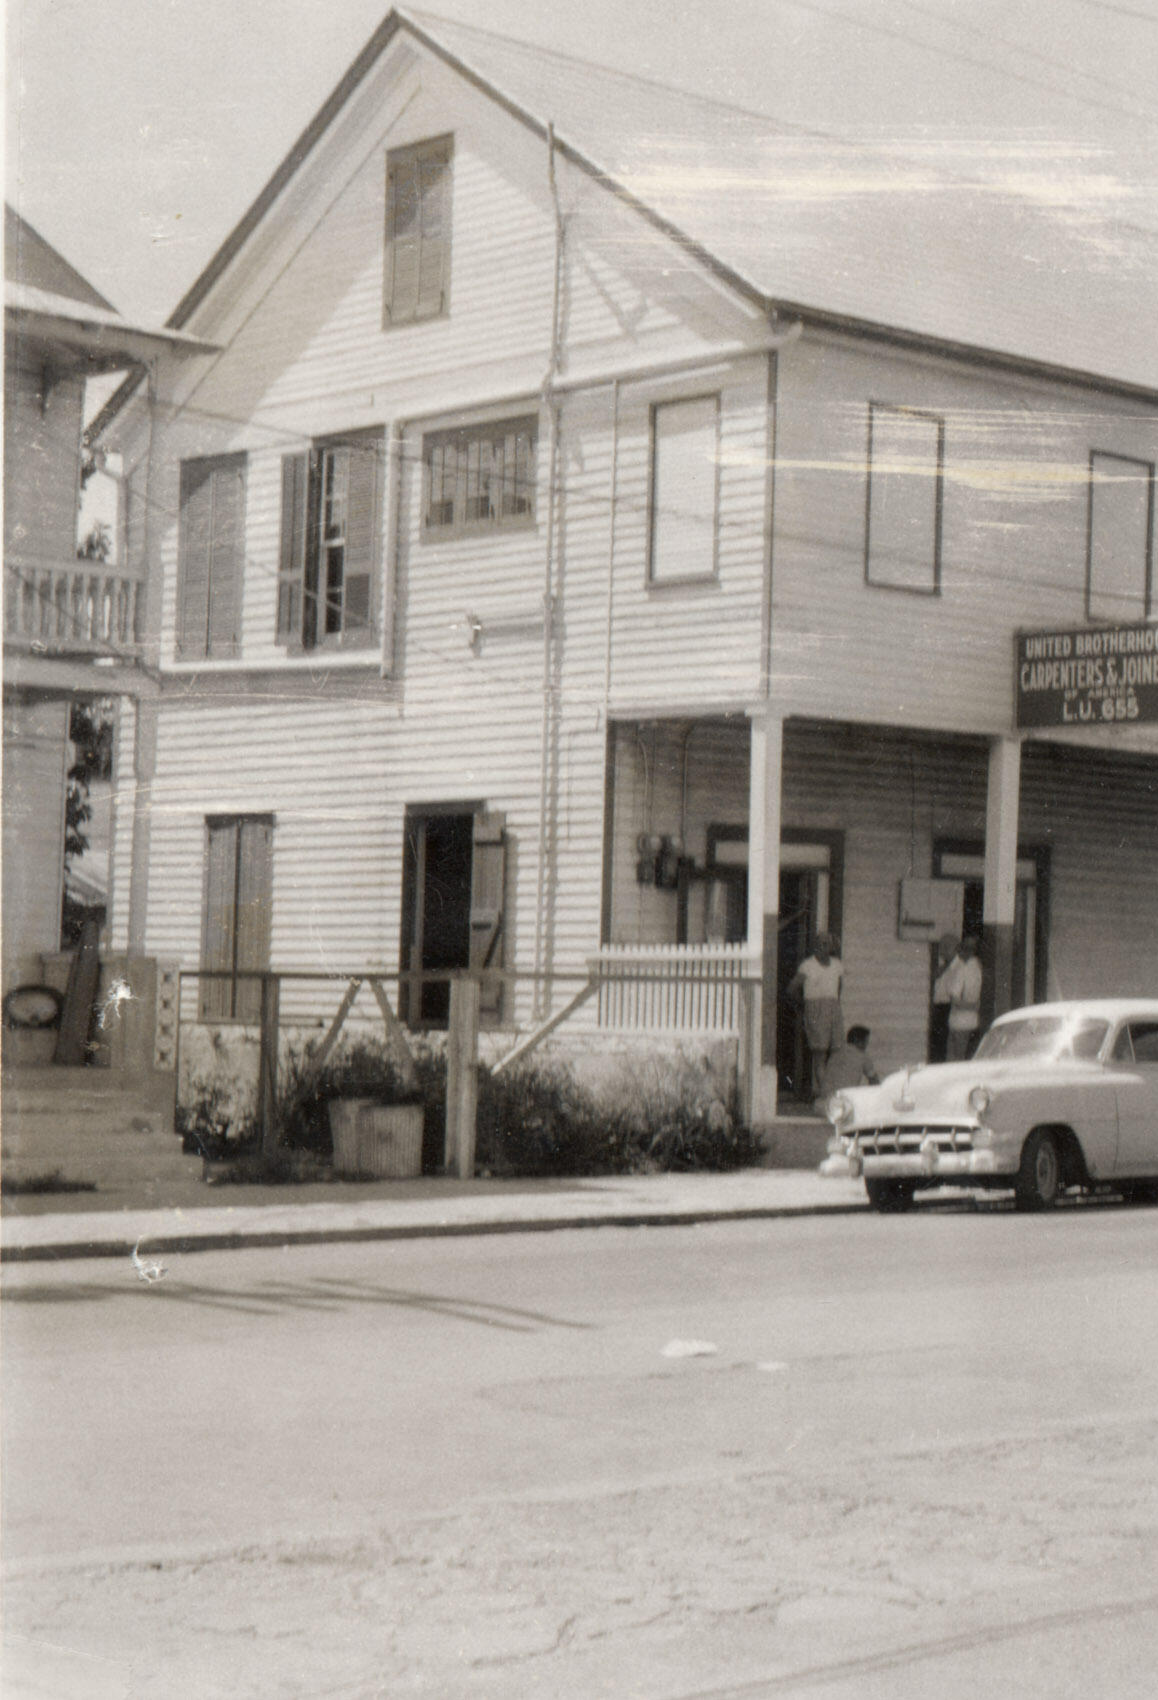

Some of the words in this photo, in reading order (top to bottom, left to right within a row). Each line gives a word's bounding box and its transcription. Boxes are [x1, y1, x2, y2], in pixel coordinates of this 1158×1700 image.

[1026, 634, 1072, 658] UNITED
[1020, 657, 1104, 692] CARPENTERS
[1106, 656, 1118, 686] &
